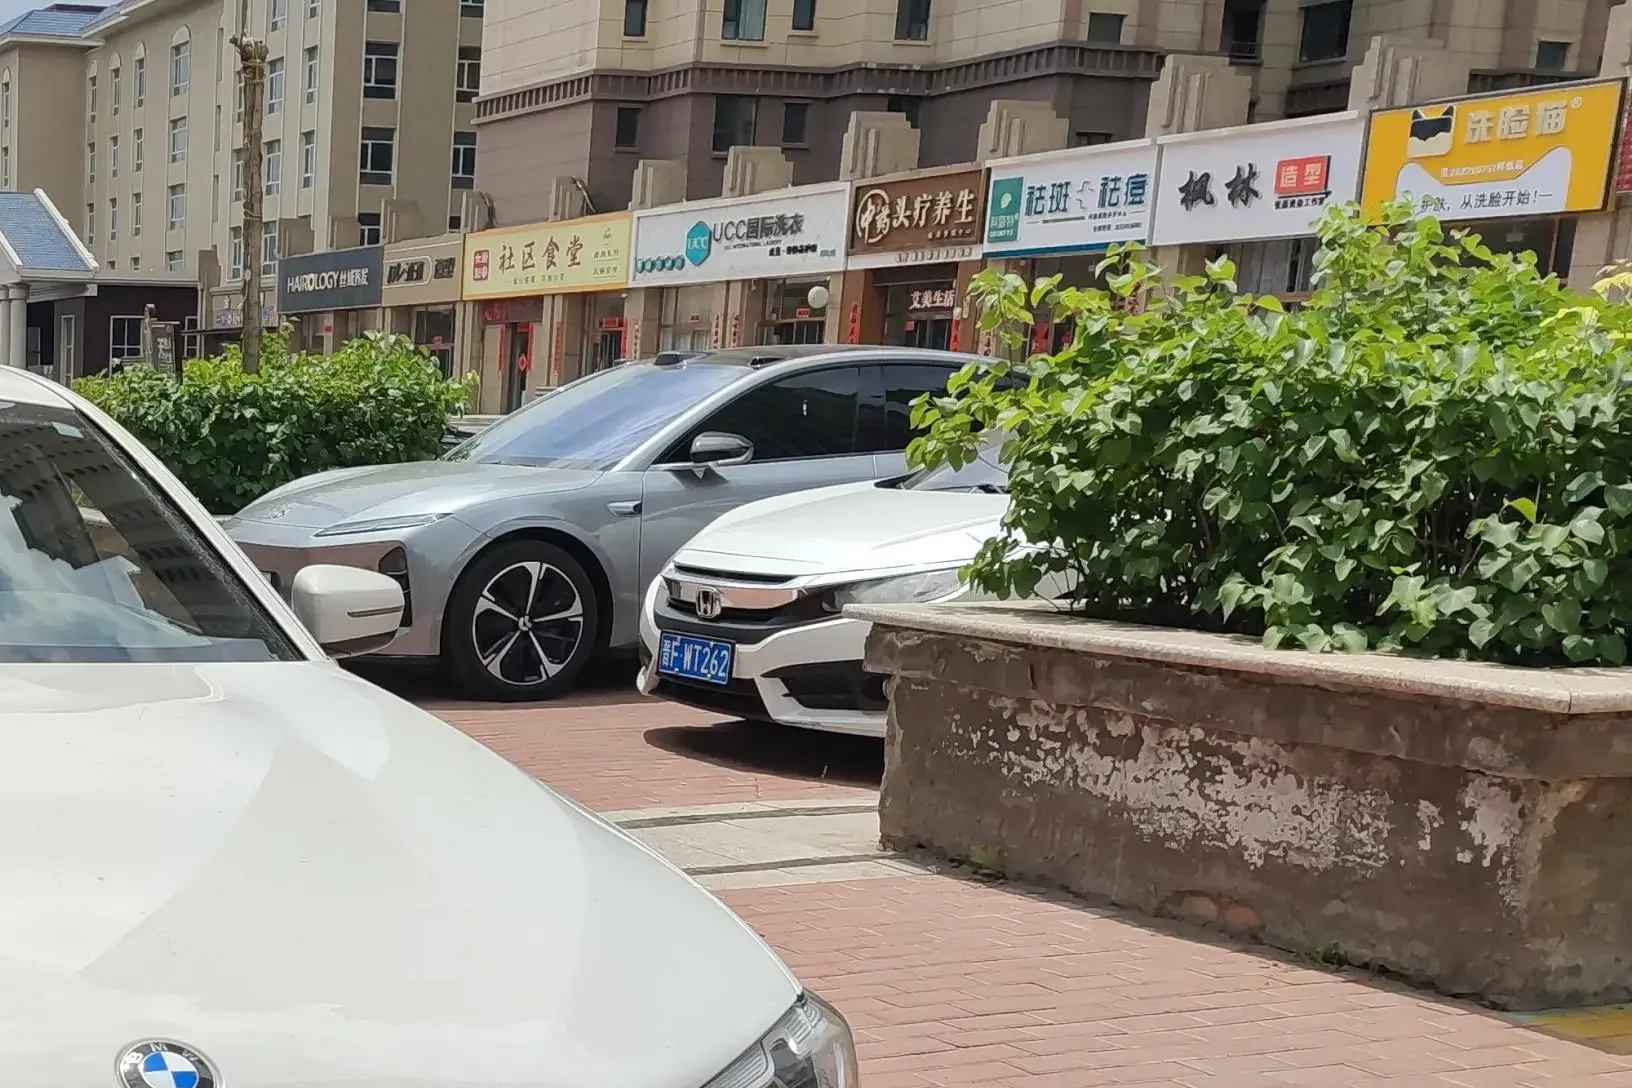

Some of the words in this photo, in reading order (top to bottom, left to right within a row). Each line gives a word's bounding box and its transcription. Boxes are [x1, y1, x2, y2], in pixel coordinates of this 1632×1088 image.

[1097, 173, 1148, 208] 祛痘
[1178, 163, 1259, 212] 枫林
[1279, 163, 1323, 188] 造型
[1025, 181, 1071, 216] 祛斑
[687, 236, 709, 250] UCC
[712, 212, 805, 243] UCC国际洗衣
[499, 234, 584, 276] 社区食堂
[287, 271, 339, 293] HAIROLOGY
